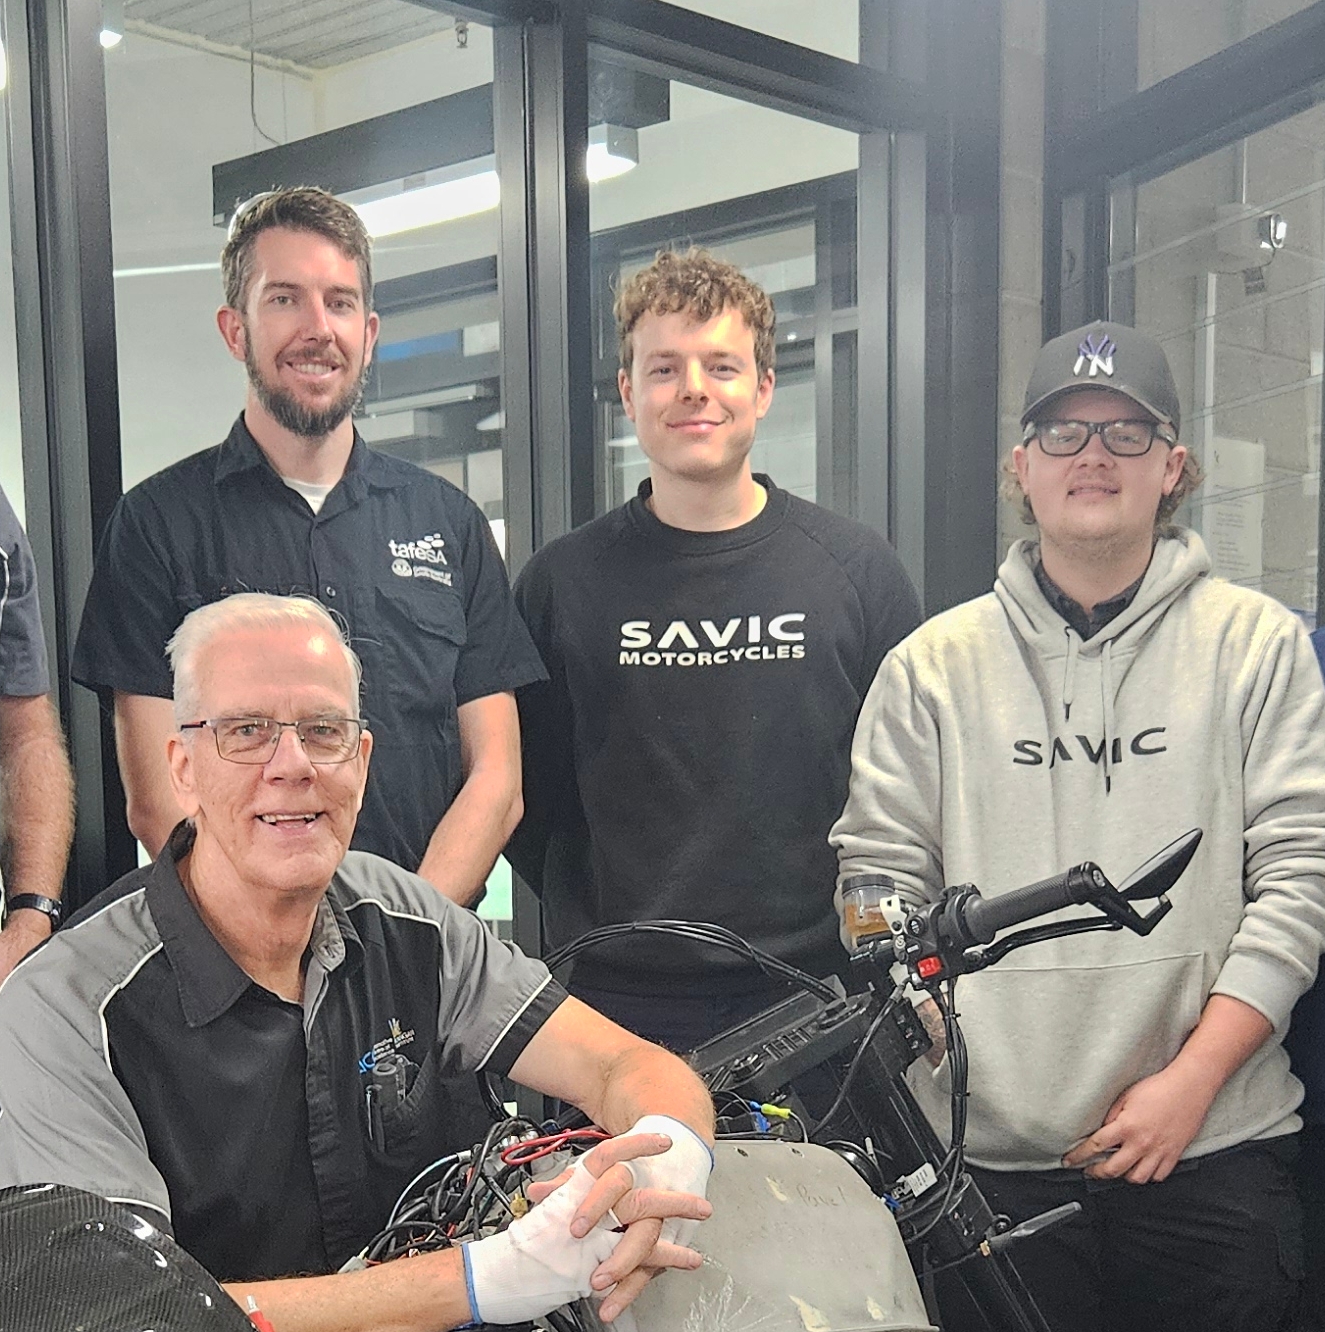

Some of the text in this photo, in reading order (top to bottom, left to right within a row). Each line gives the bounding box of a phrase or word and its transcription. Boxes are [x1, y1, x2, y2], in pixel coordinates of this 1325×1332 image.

[620, 612, 806, 649] SAVIC
[619, 644, 805, 667] MOTORCYCLES
[1013, 727, 1168, 769] SAVIC
